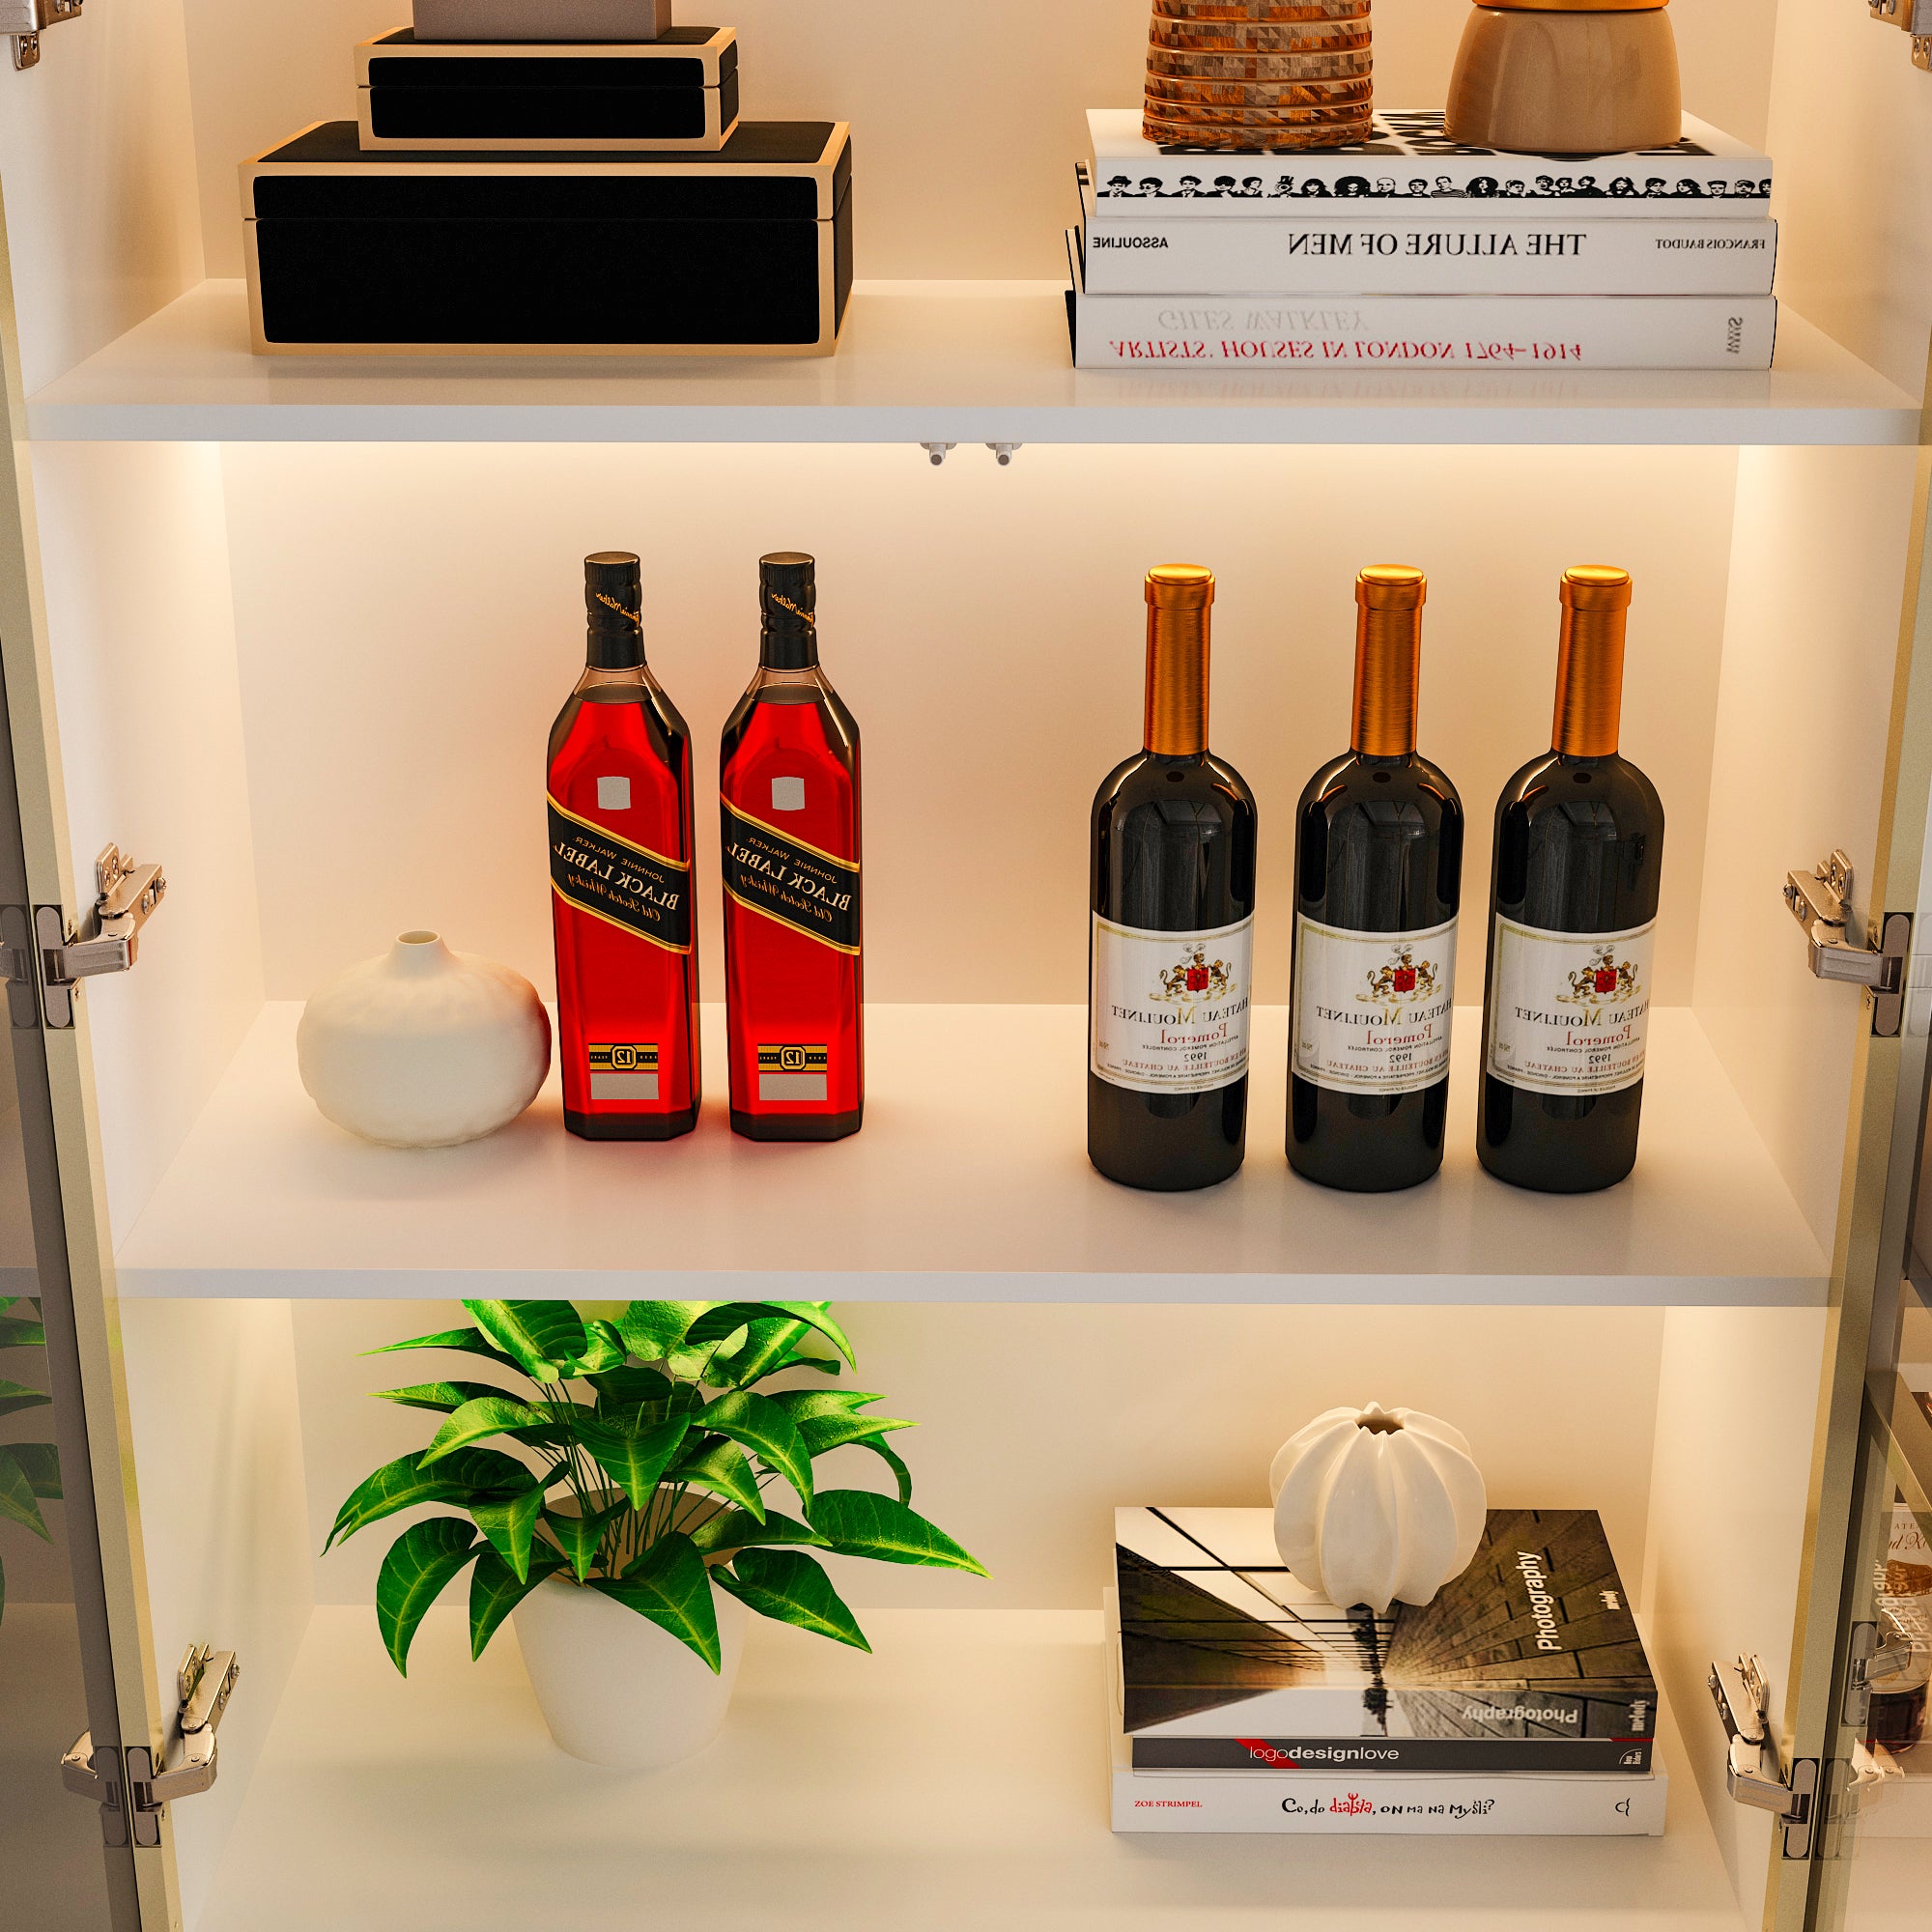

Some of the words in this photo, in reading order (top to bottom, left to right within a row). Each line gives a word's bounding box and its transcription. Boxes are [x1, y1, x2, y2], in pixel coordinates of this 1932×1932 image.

[1516, 1550, 1562, 1651] Photography
[1461, 1705, 1578, 1723] Photography
[1250, 1747, 1400, 1762] logodesignlove
